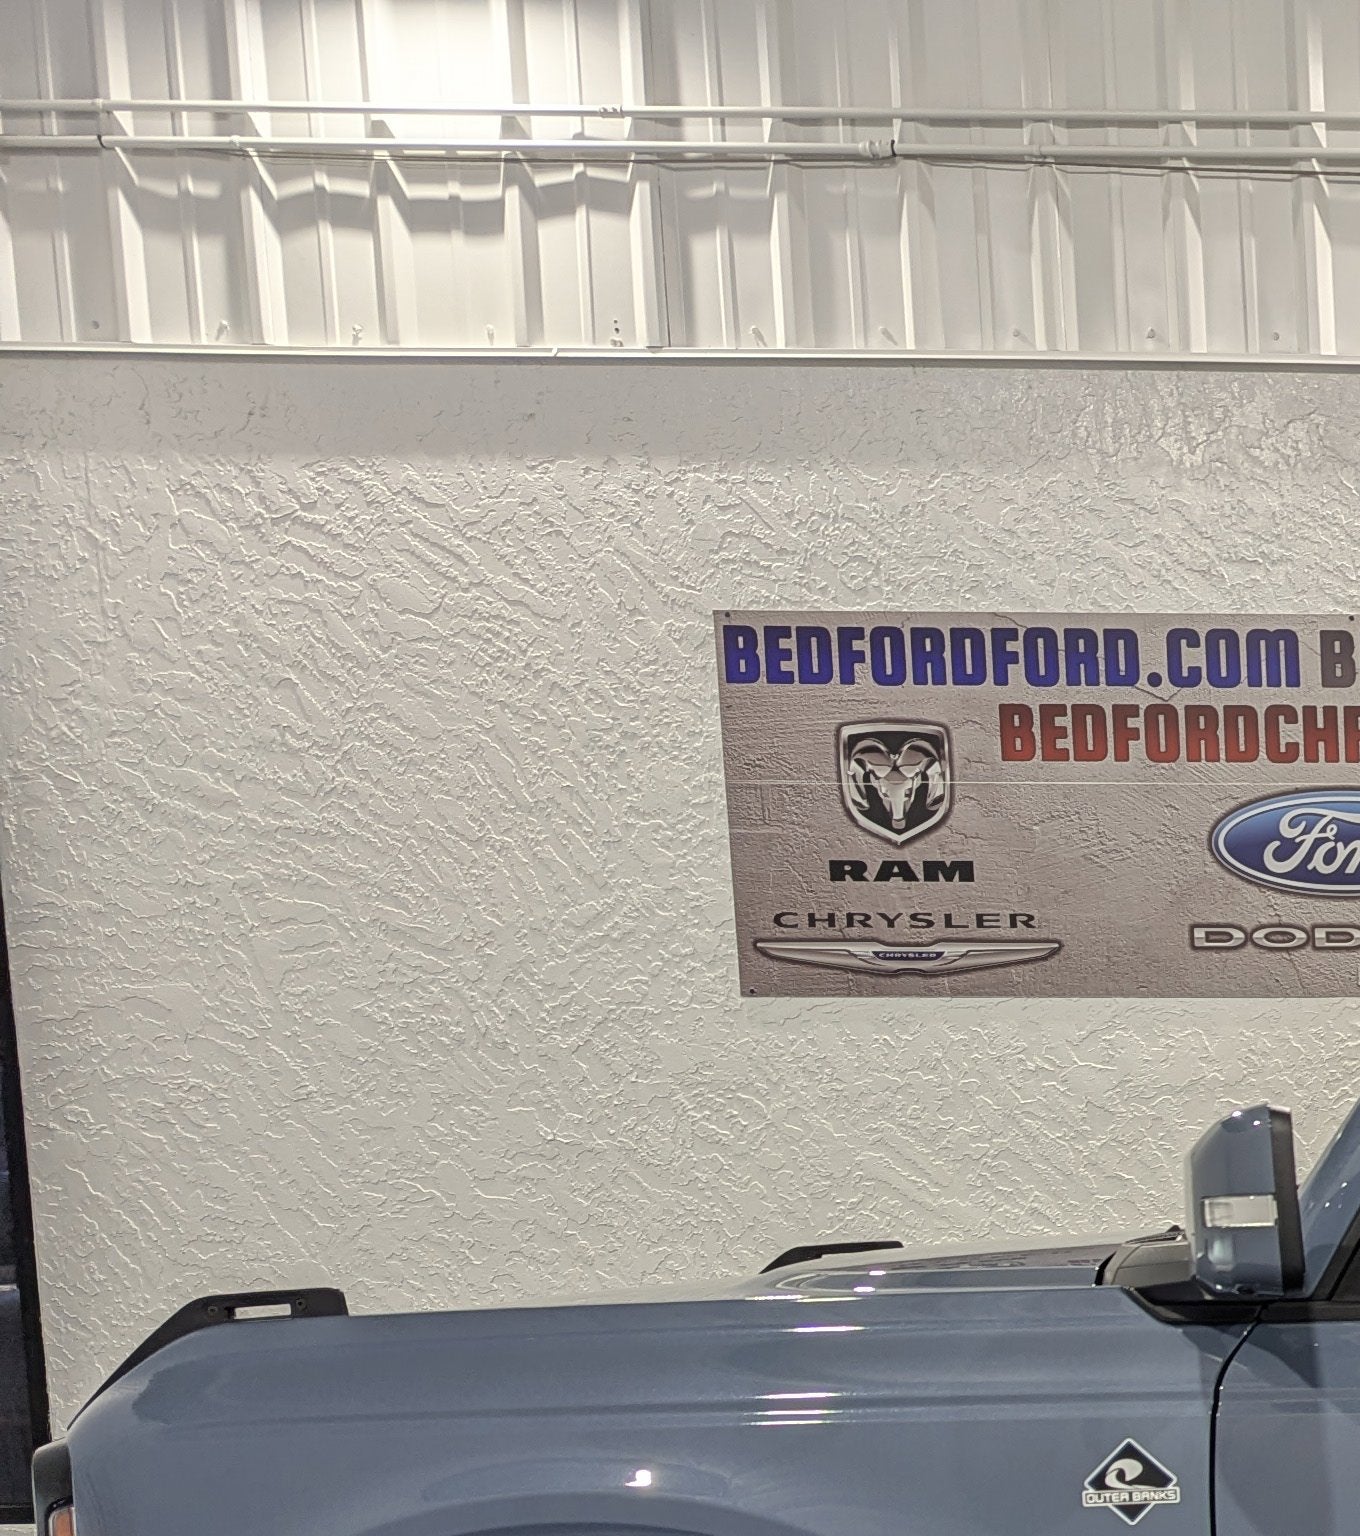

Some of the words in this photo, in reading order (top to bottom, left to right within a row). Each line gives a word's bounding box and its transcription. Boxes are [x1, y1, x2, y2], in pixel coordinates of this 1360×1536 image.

[722, 624, 1301, 688] BEDFORDFORD.COM
[828, 859, 975, 882] RAM
[772, 911, 1036, 929] CHRYSLER
[1086, 1492, 1130, 1504] OUTER
[1132, 1489, 1176, 1502] BANKS
